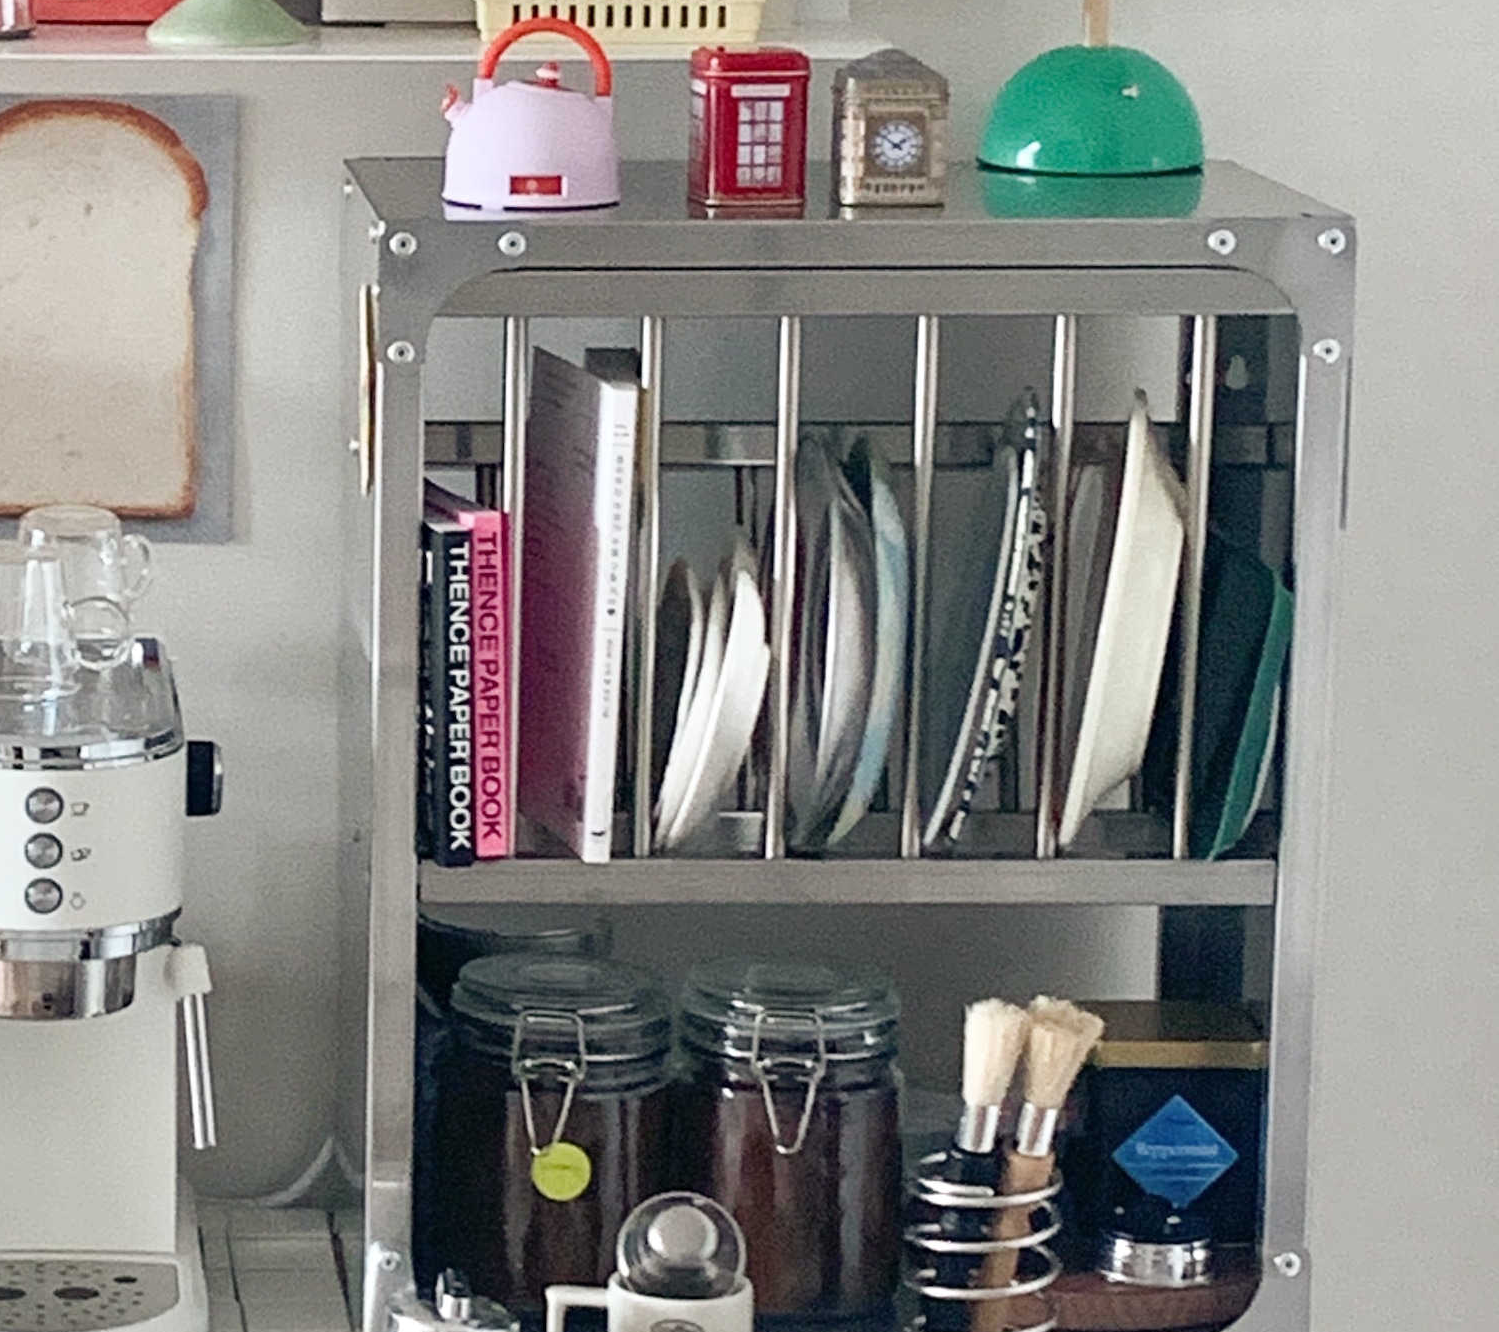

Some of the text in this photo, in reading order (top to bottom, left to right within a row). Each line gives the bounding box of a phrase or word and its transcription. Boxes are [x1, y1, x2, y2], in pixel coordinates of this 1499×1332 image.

[449, 541, 472, 850] THENCE PAPER BOOK
[478, 531, 502, 839] THENCE PAPER BOOK
